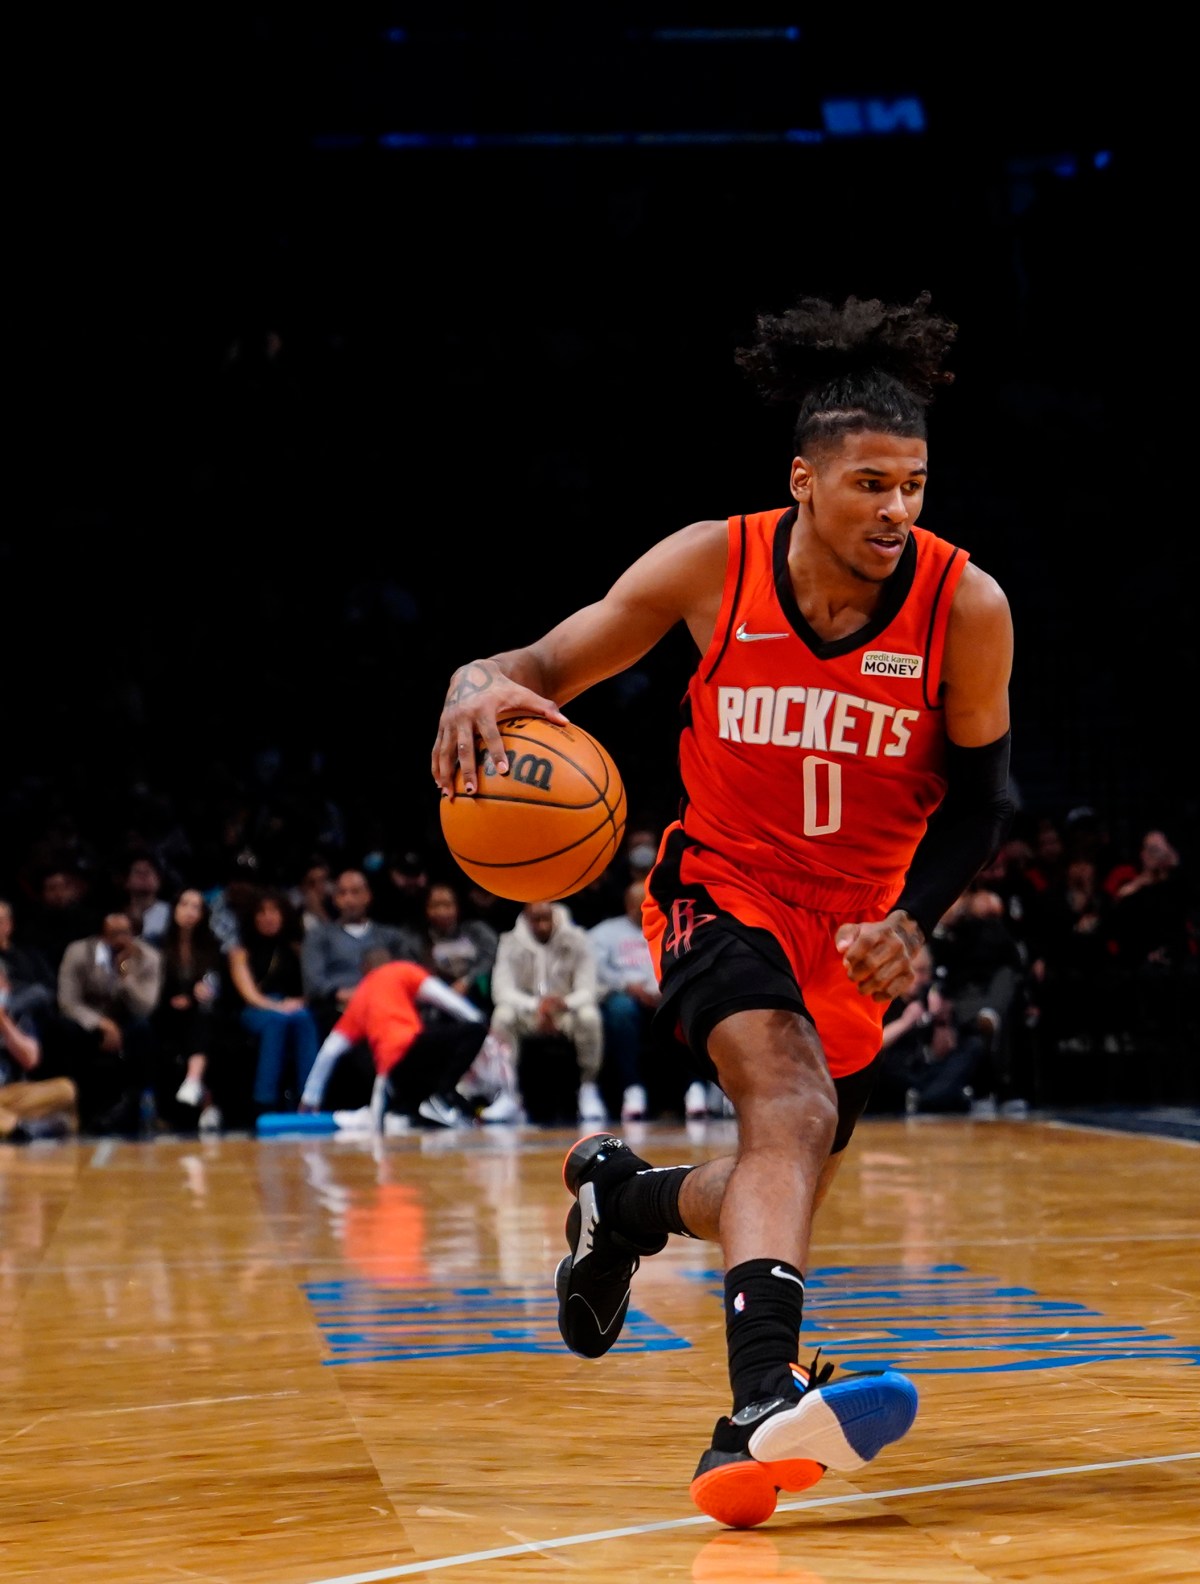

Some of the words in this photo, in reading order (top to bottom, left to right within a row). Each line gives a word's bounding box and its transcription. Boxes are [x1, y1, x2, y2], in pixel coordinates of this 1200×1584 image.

[864, 661, 918, 676] MONEY
[866, 653, 889, 663] credit
[891, 655, 919, 665] karma
[717, 686, 920, 757] ROCKETS
[802, 755, 842, 837] 0
